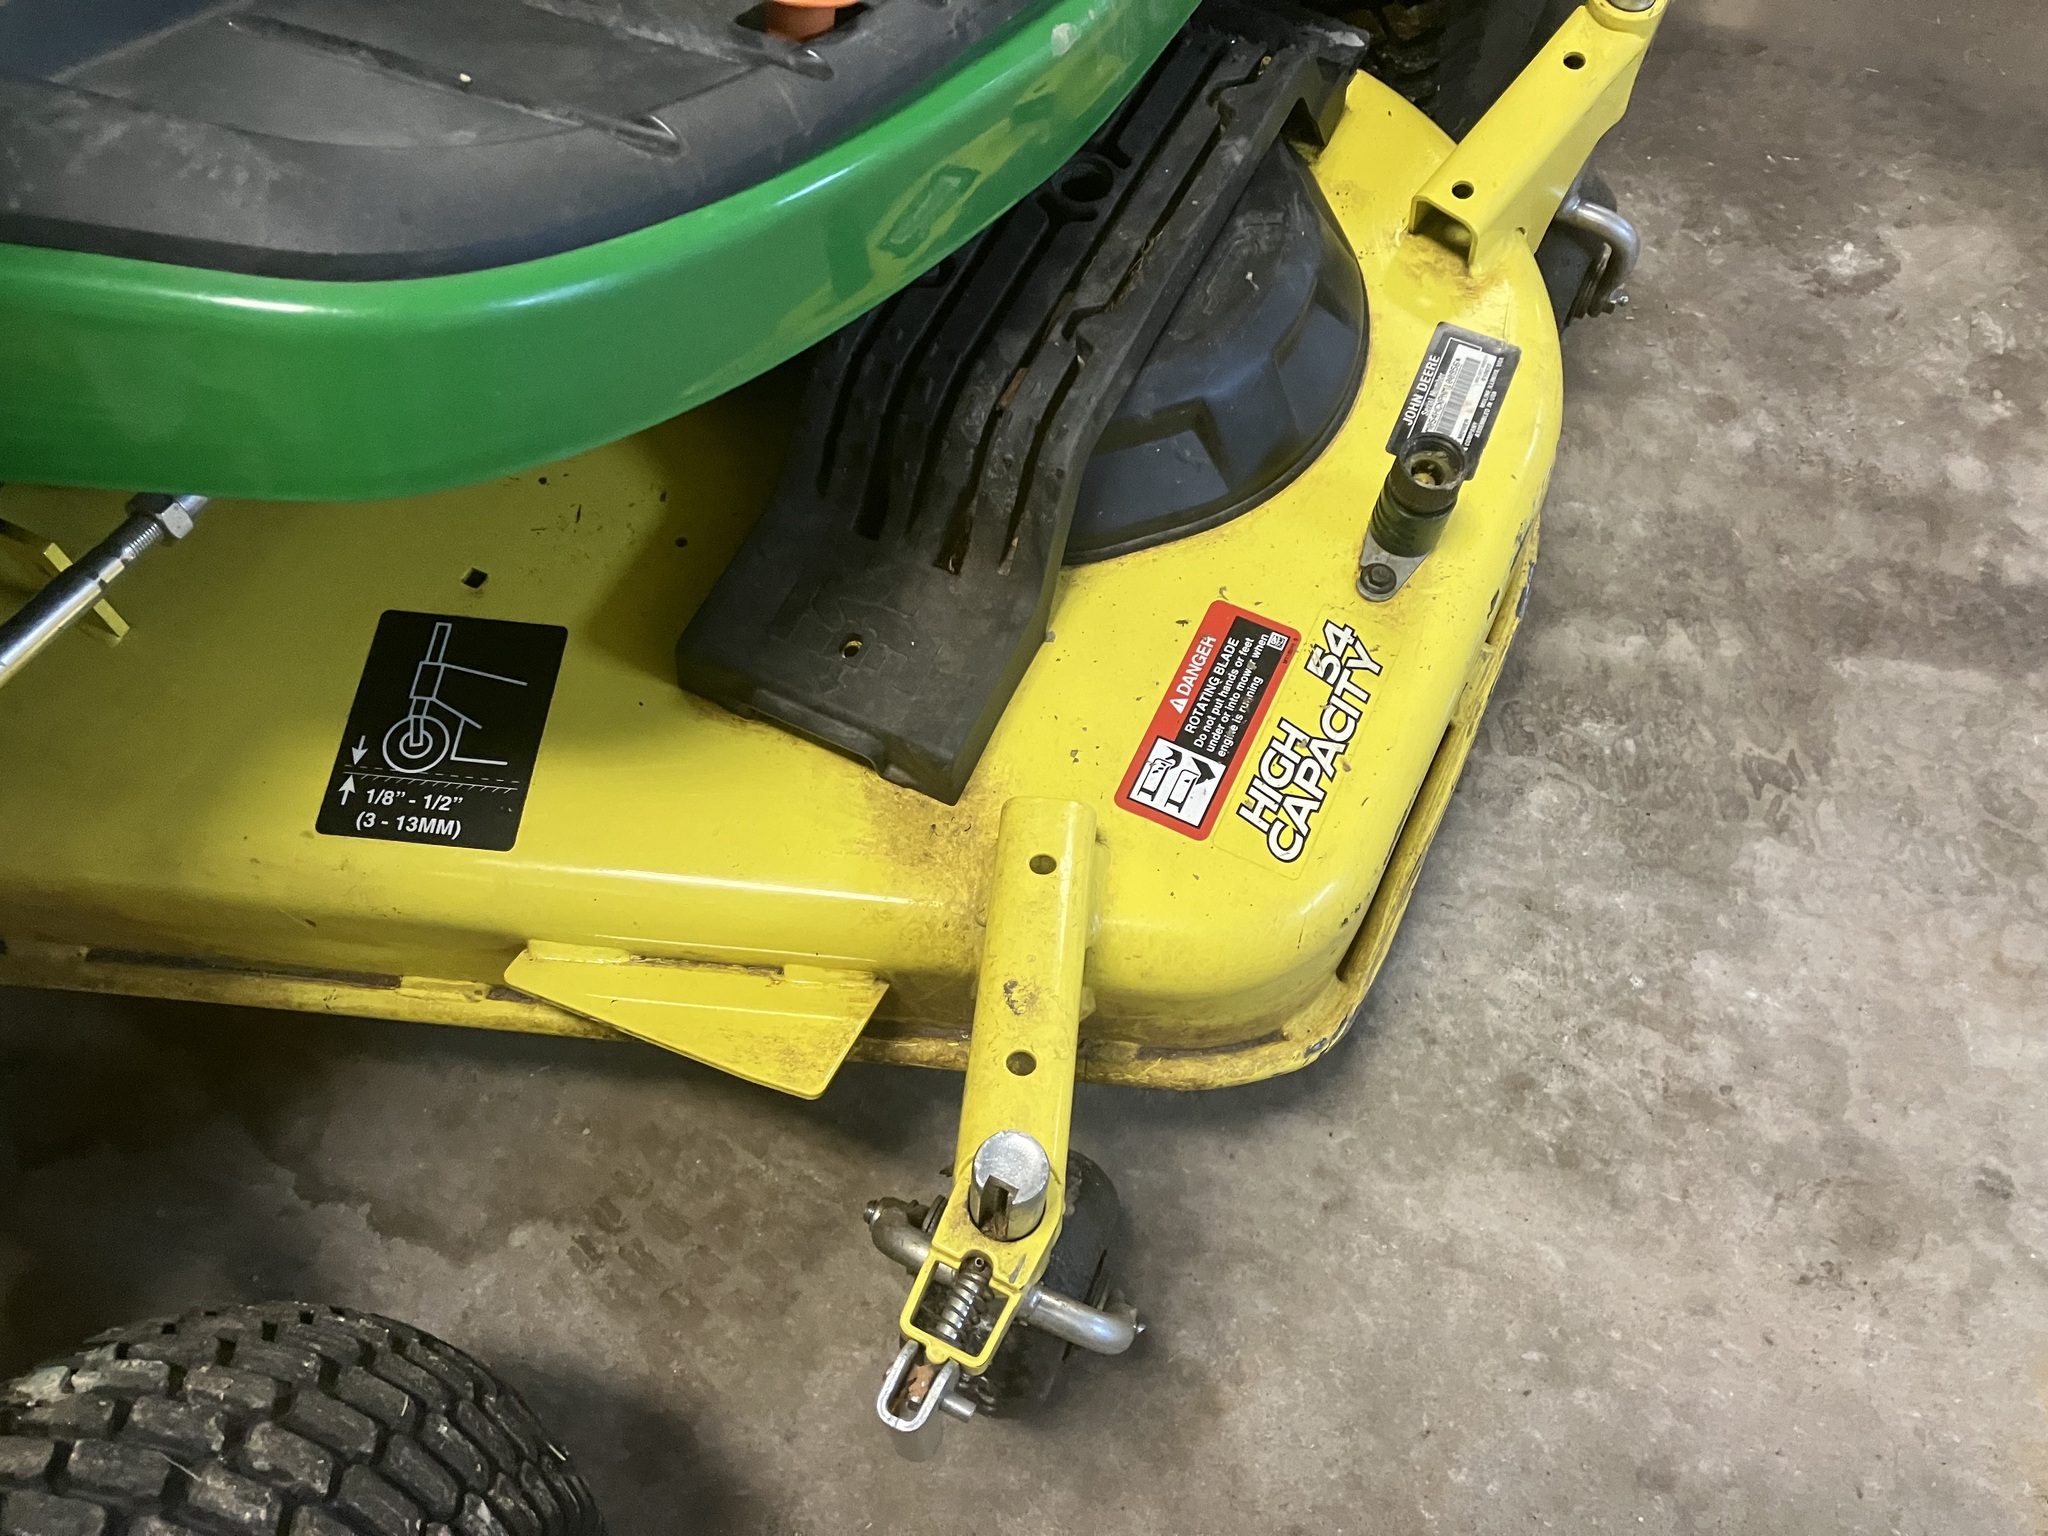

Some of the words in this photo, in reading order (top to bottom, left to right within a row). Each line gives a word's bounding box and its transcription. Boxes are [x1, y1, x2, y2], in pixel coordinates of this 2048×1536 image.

[1401, 392, 1423, 426] JOHN
[1415, 354, 1440, 392] DEERE
[1238, 636, 1254, 656] feet
[1251, 633, 1268, 658] when
[1304, 619, 1355, 686] 54
[1176, 635, 1216, 696] DANGER
[1233, 655, 1244, 667] or
[1235, 658, 1256, 691] mowr
[1183, 675, 1221, 734] ROTATING
[1213, 636, 1239, 676] BLADE
[1218, 667, 1239, 698] hands
[1211, 697, 1224, 716] put
[1225, 691, 1240, 711] into
[1201, 714, 1216, 732] not
[1220, 711, 1231, 723] or
[1232, 712, 1243, 723] is
[1193, 731, 1207, 747] Do
[1205, 723, 1225, 752] under
[1266, 636, 1383, 863] CAPACITY
[1236, 717, 1310, 833] HIGH
[356, 811, 376, 830] (3
[397, 815, 461, 840] 13MM)
